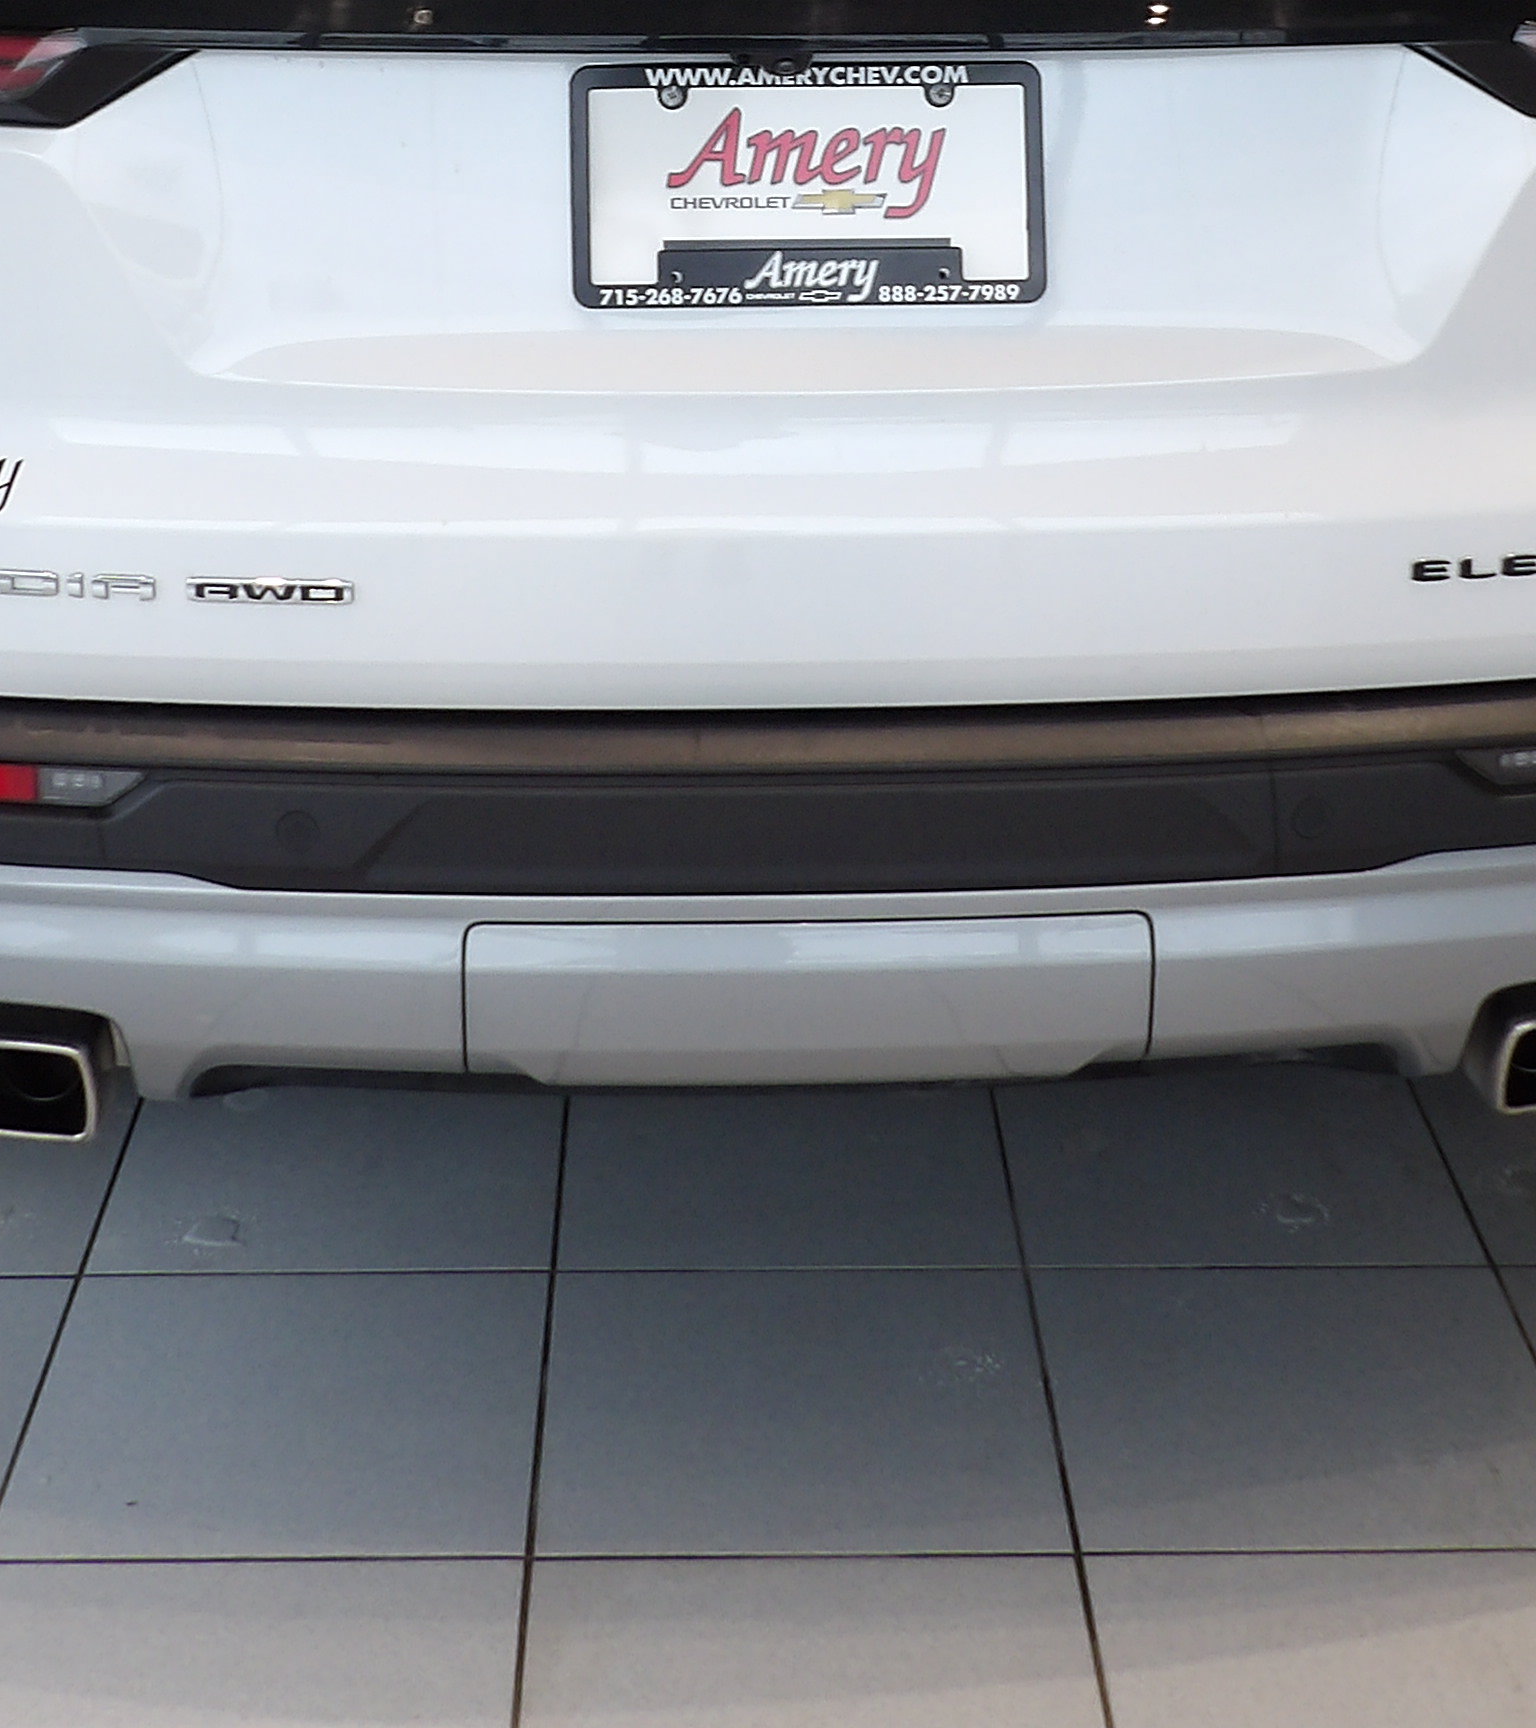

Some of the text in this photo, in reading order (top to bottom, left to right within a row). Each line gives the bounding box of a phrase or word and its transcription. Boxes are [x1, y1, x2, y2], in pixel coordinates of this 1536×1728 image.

[667, 106, 947, 219] Amery
[670, 195, 792, 210] CHEVROLET
[744, 250, 880, 303] Amery
[599, 285, 744, 305] 715-268-7676
[878, 284, 1021, 303] 888-257-7989
[188, 578, 352, 604] AWD
